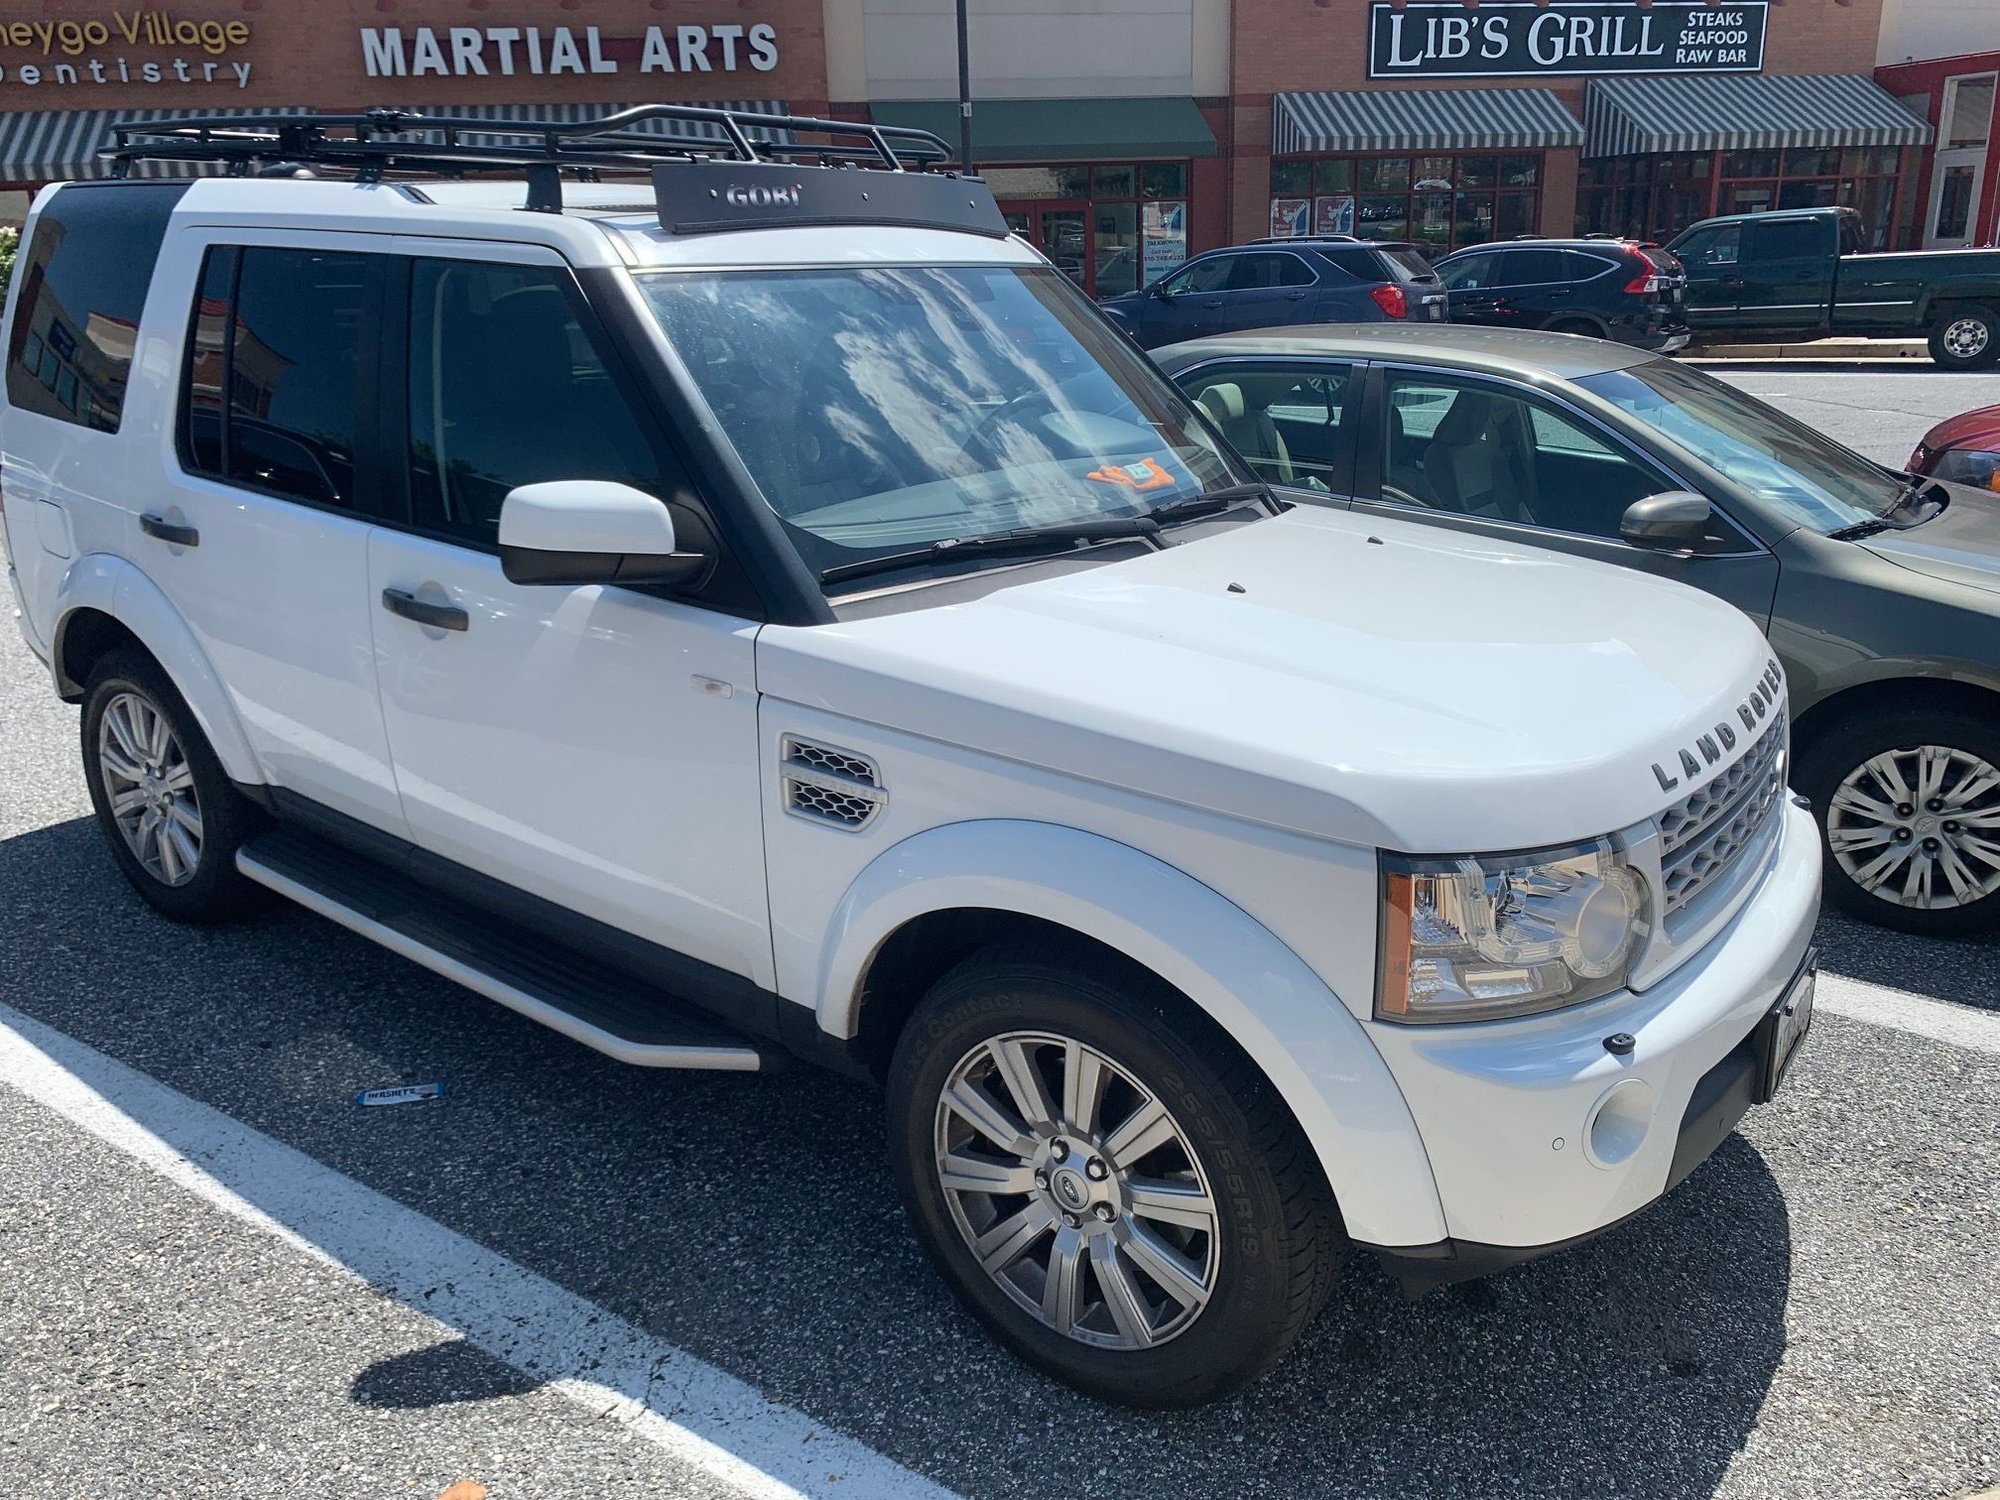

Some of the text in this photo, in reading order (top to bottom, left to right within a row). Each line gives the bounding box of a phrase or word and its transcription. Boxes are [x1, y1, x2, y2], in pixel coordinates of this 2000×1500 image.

[113, 11, 250, 55] Village
[1679, 30, 1748, 45] SEAFOOD
[1687, 11, 1744, 27] STEAKS
[360, 23, 779, 77] MARTIAL ARTS
[1387, 12, 1664, 67] LIB'S GRILL
[1675, 48, 1747, 63] RAW BAR
[0, 57, 252, 89] entistry
[1651, 658, 1782, 793] LAND ROVER
